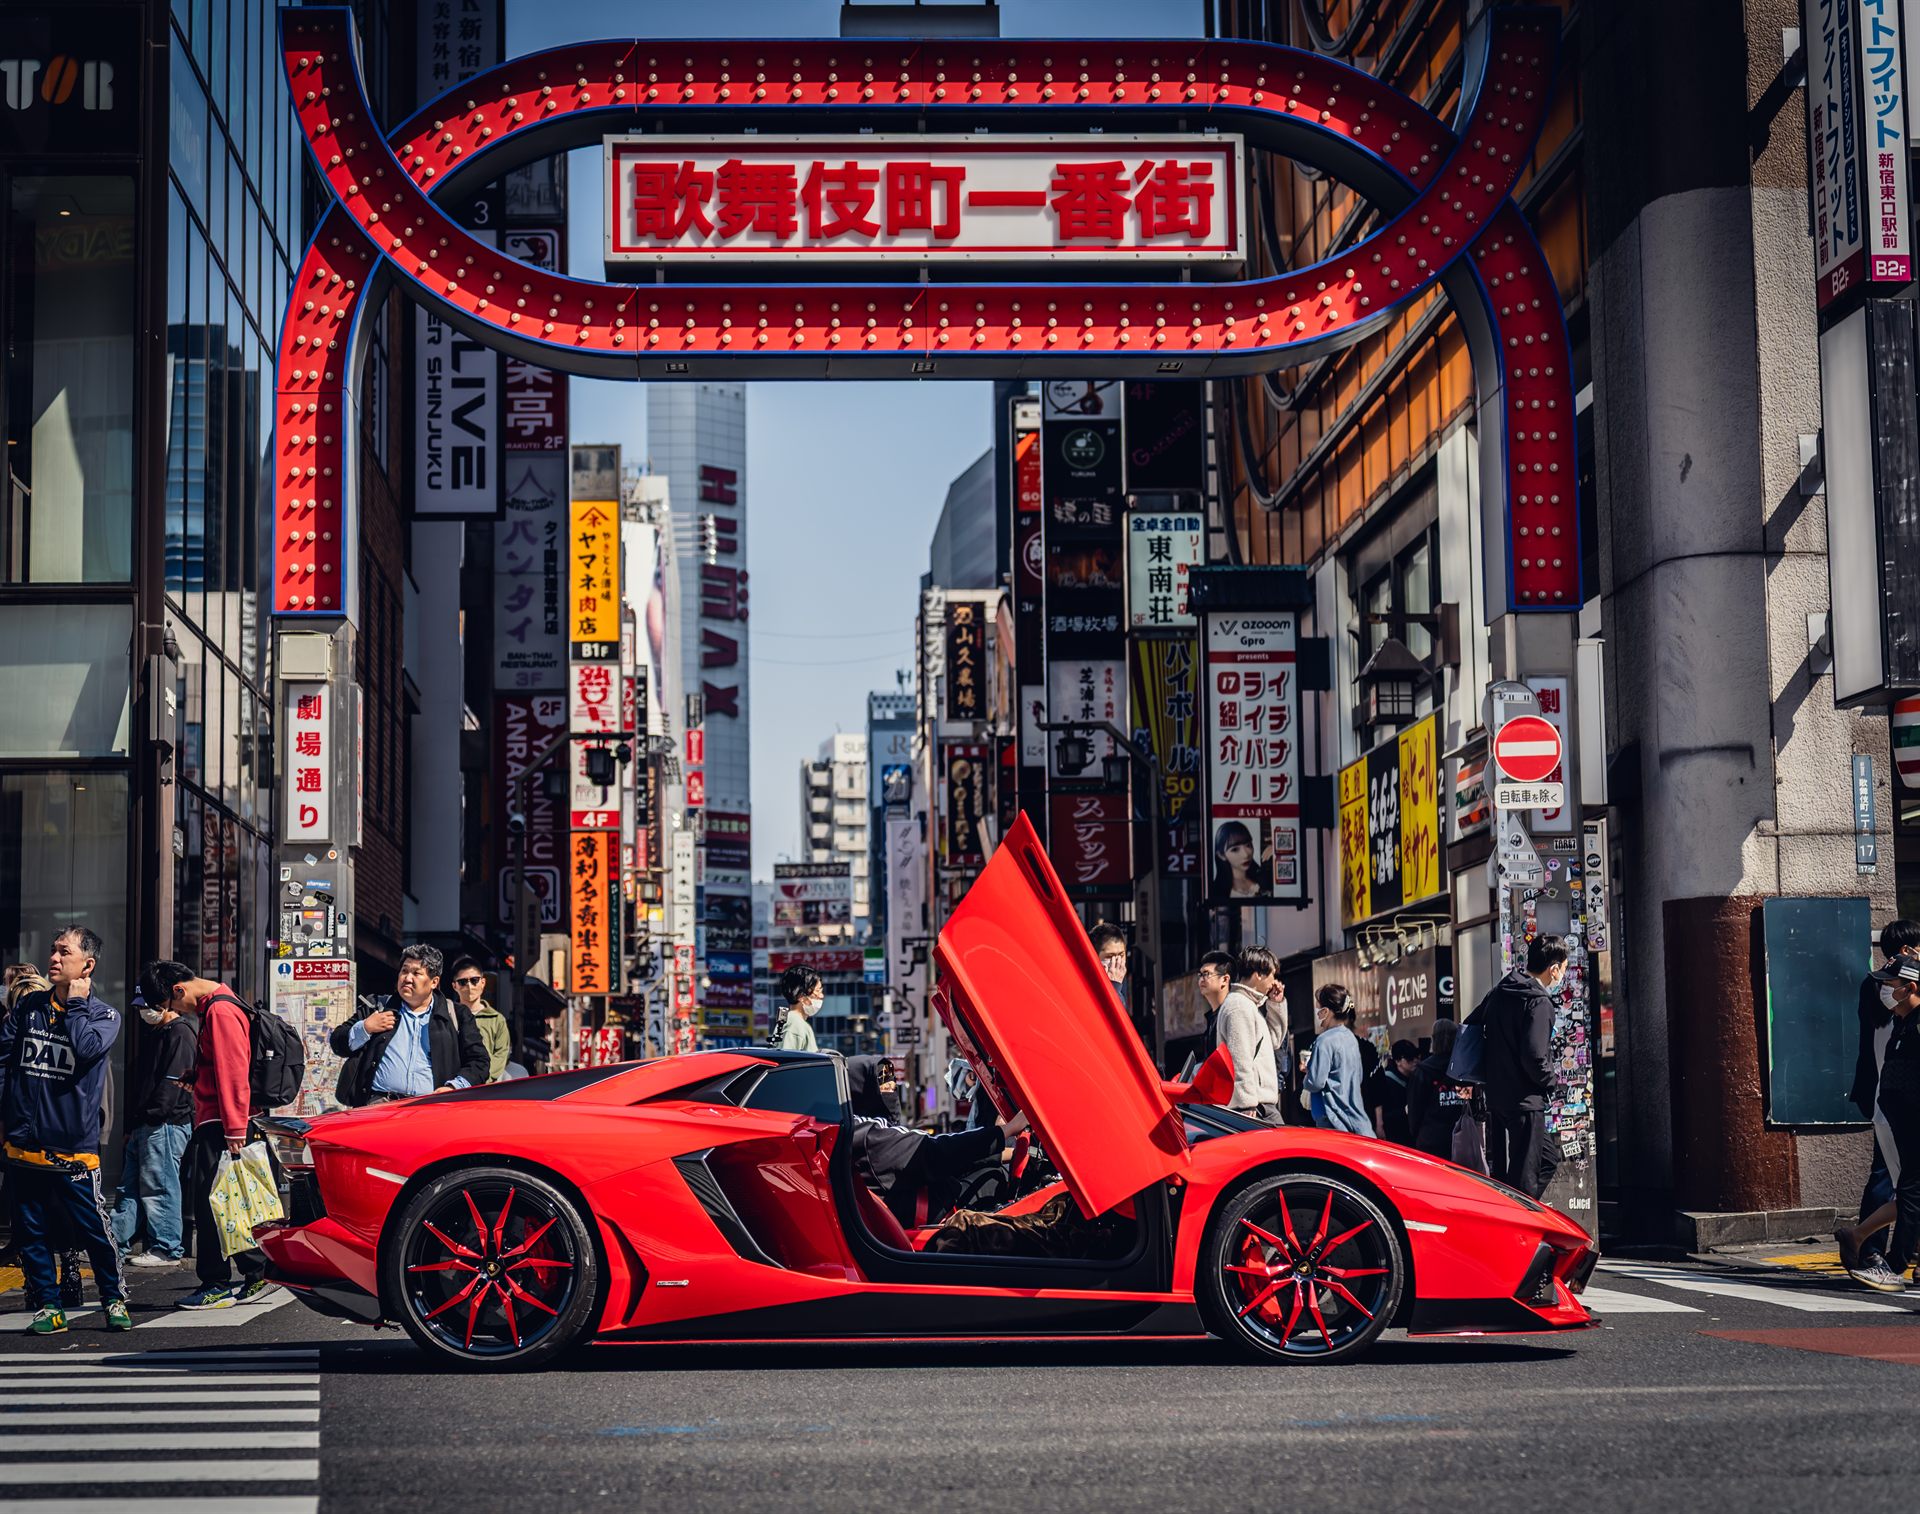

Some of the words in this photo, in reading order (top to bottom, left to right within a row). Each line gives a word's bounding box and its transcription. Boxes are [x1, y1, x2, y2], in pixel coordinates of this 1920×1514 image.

[1813, 104, 1829, 268] 新宿東口駅前
[633, 159, 1215, 241] 歌舞伎町一番街
[1878, 153, 1899, 249] 新宿東口駅前
[474, 201, 489, 224] 3
[1876, 260, 1907, 277] B2F
[1832, 267, 1849, 297] B2F
[427, 357, 442, 490] SHINJUKU
[545, 436, 564, 449] 2F
[1132, 517, 1200, 532] 全卓全自動
[1190, 534, 1200, 566] リー
[502, 519, 539, 644] バンタイ
[577, 531, 598, 637] ヤマネ肉店
[1147, 535, 1174, 624] 東南荘
[1133, 613, 1146, 625] 3F
[1242, 620, 1291, 630] azooom
[1240, 636, 1265, 647] Gpro
[581, 643, 609, 658] B1F
[1237, 653, 1270, 661] presents
[515, 671, 543, 687] 3F
[539, 701, 562, 716] 2F
[1165, 642, 1194, 772] ハイボール
[295, 694, 322, 829] 劇場通り
[1500, 788, 1558, 804] 自転車を除く
[582, 811, 609, 827] 4F
[1238, 808, 1272, 817] まいまい
[1073, 796, 1109, 883] ステップ
[1859, 844, 1875, 857] 17
[1166, 855, 1197, 872] 2F
[1860, 865, 1877, 873] 17-2
[1402, 1004, 1424, 1019] ENERGY
[23, 1039, 73, 1070] DAL
